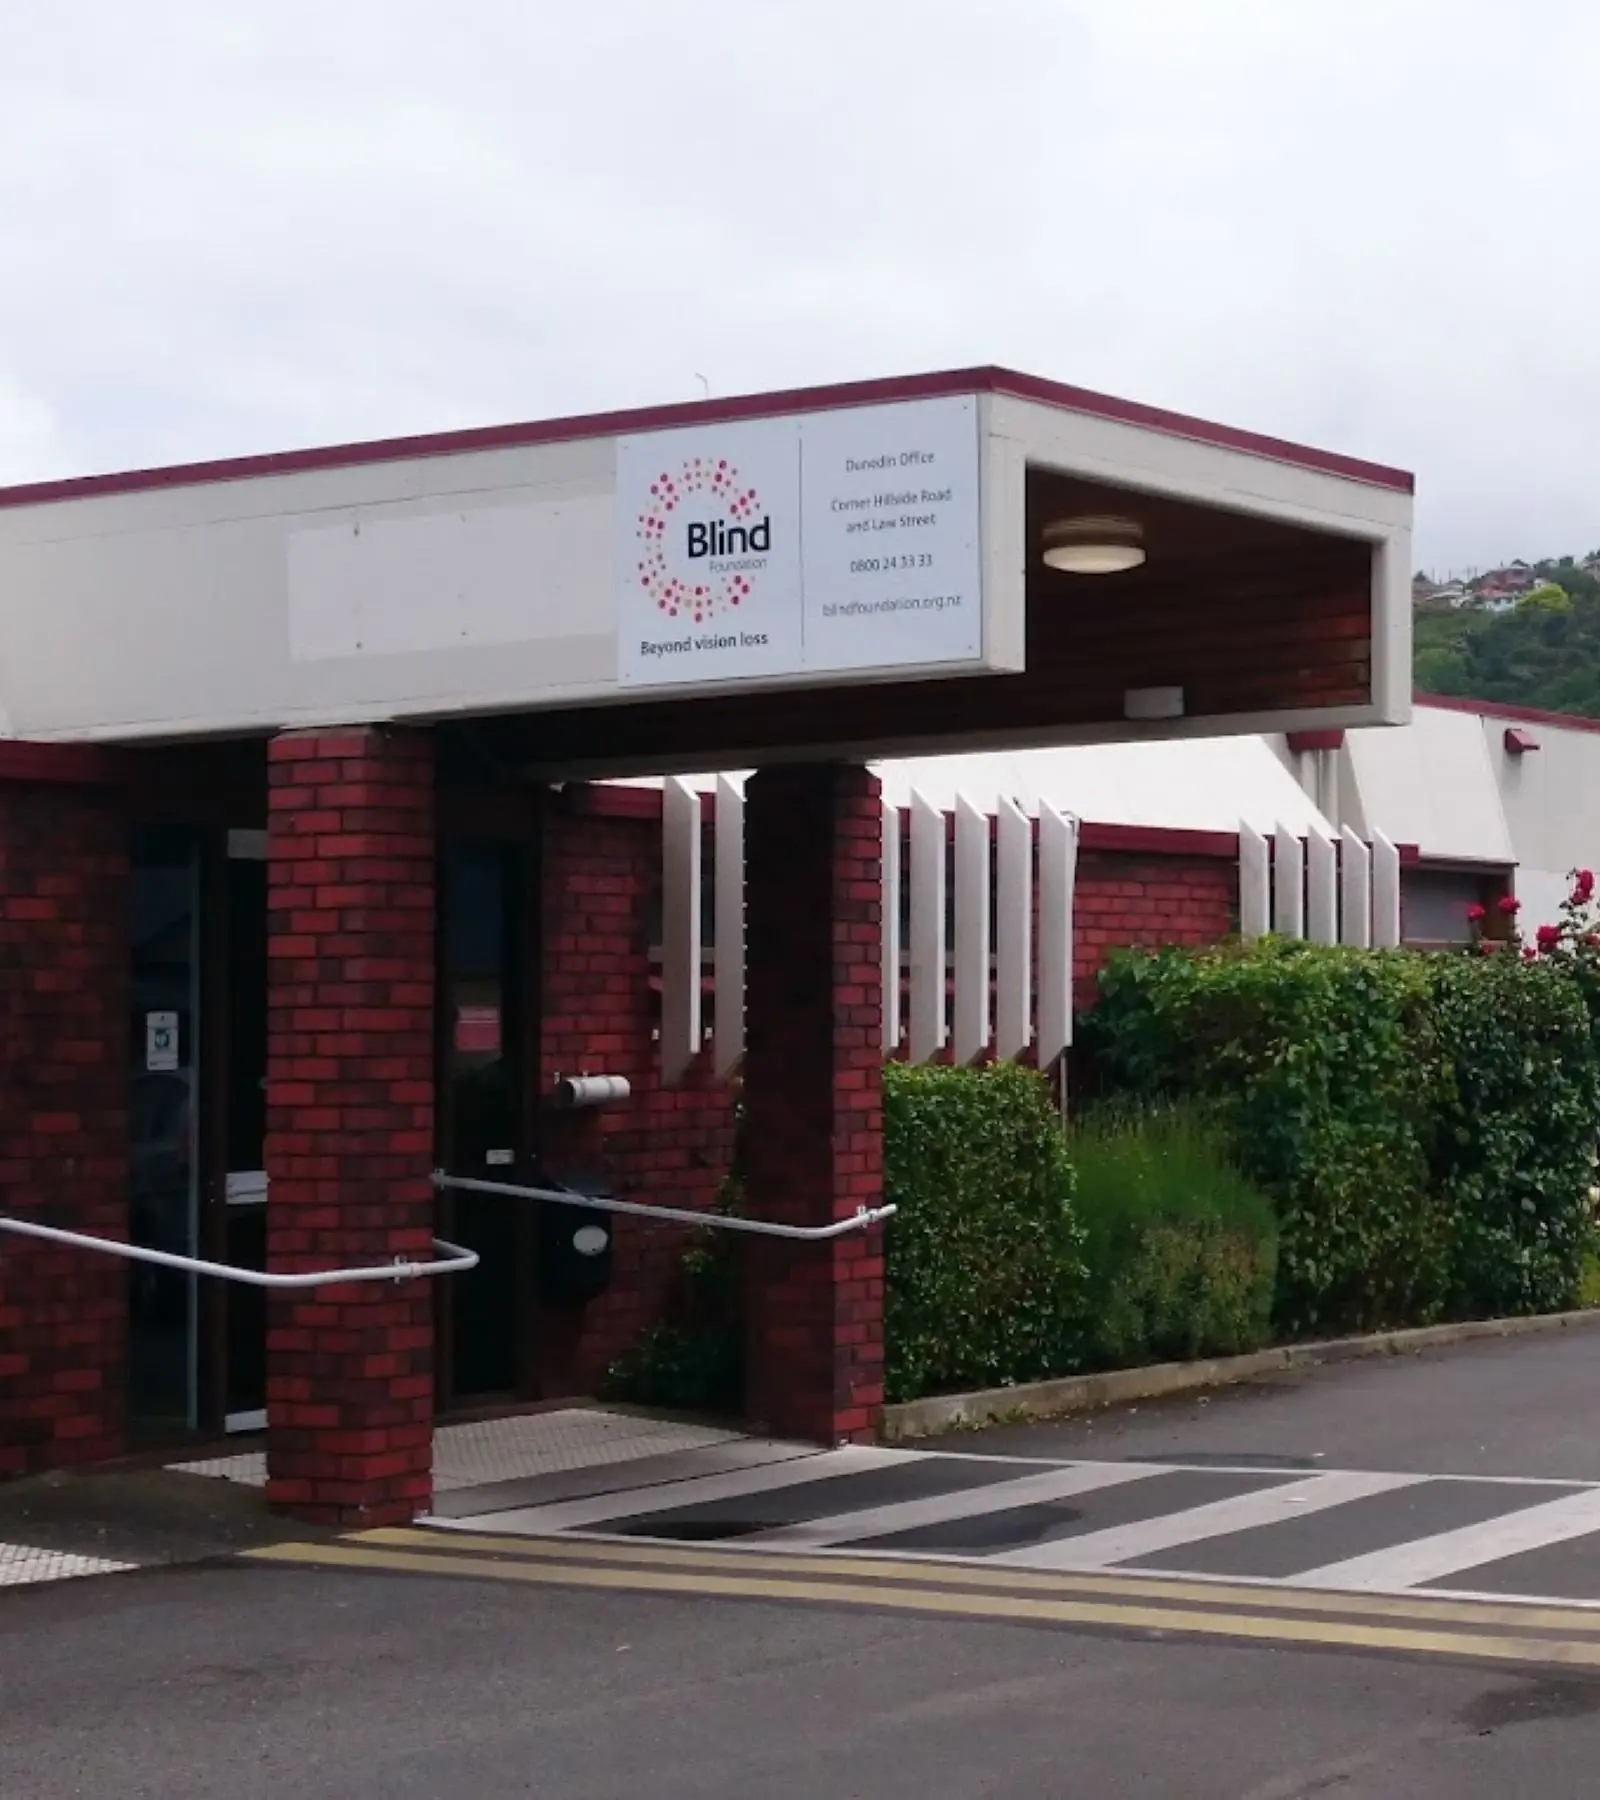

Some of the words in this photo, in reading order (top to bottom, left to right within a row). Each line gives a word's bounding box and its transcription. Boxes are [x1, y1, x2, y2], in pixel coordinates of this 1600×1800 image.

[845, 455, 897, 472] Dunedin
[899, 450, 935, 467] Office
[831, 498, 871, 512] Corner
[873, 490, 918, 507] Hillside
[920, 487, 952, 503] Road
[845, 519, 871, 533] and
[899, 513, 936, 527] Street
[687, 515, 770, 559] Blind
[709, 558, 767, 573] Foundation
[850, 558, 880, 573] 0800
[882, 556, 897, 569] 24
[919, 553, 933, 567] 33
[640, 636, 692, 658] Beyond
[694, 634, 738, 651] vision
[739, 631, 769, 647] loss
